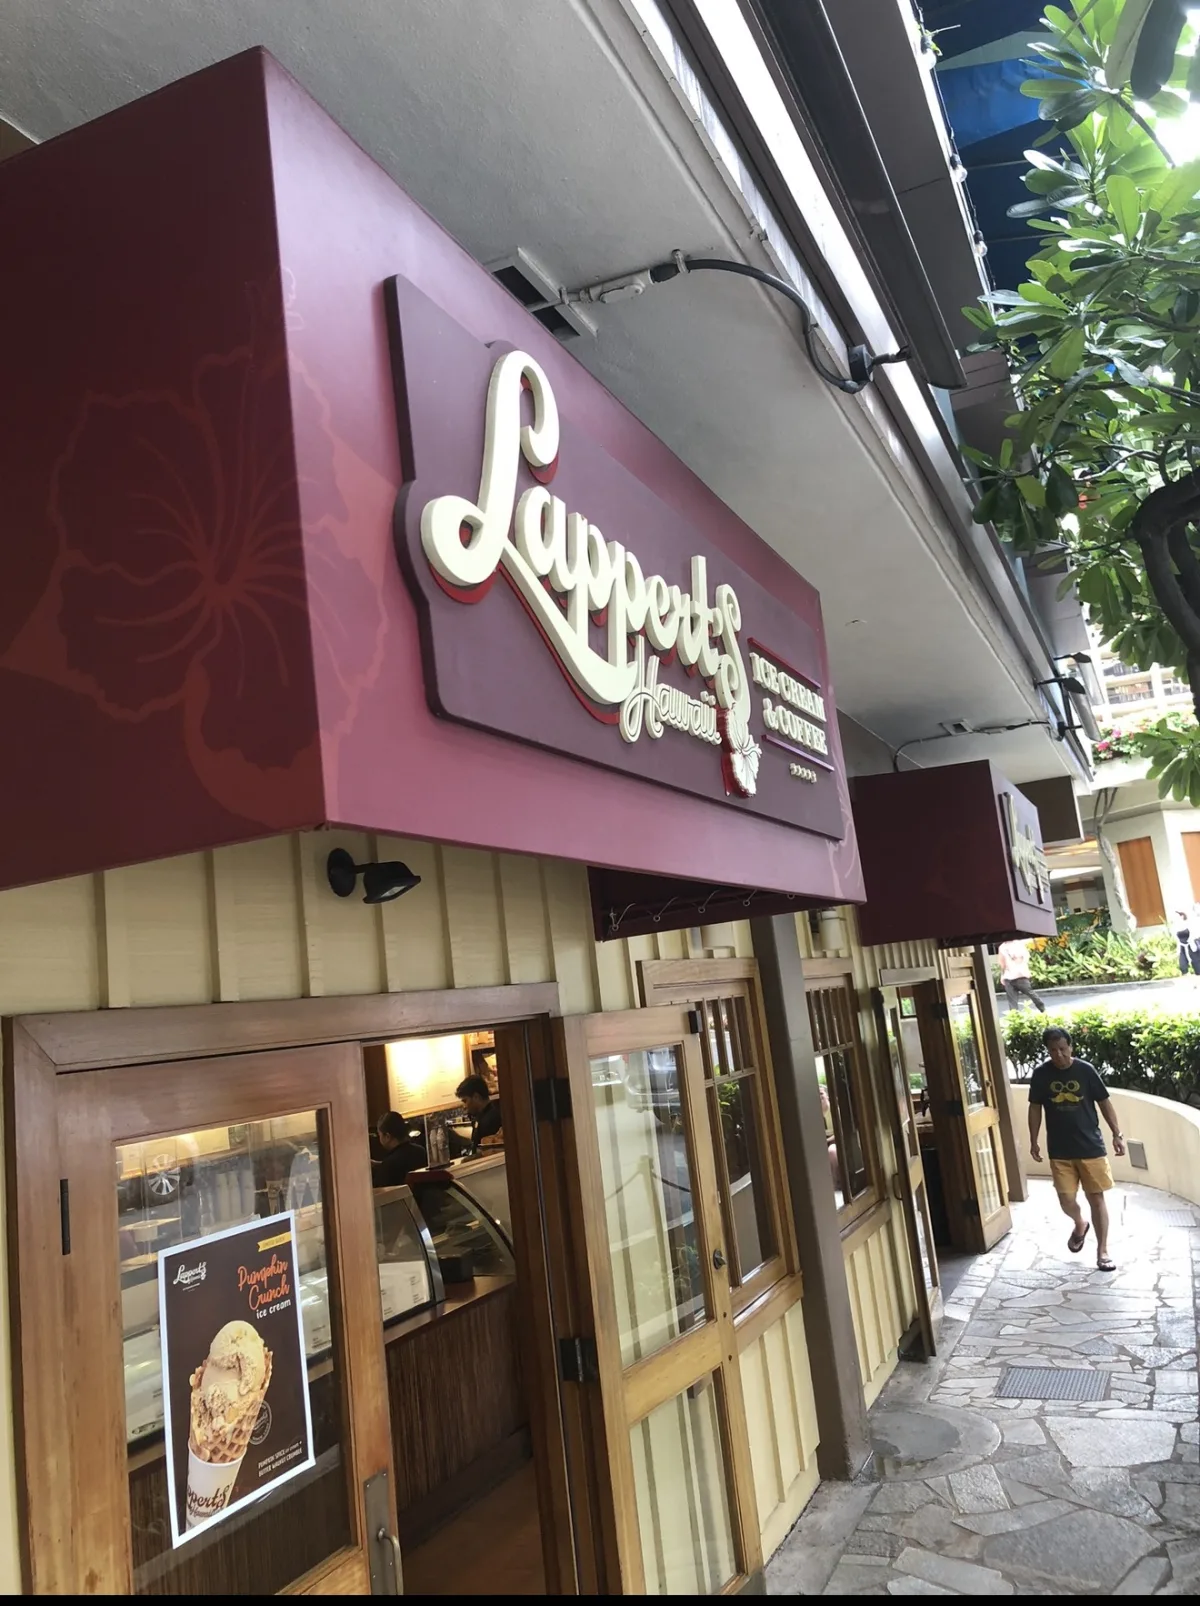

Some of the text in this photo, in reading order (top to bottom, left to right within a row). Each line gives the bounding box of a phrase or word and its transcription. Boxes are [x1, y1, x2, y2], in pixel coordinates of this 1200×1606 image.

[420, 350, 750, 722] Lappert's
[619, 634, 722, 746] Hawaii
[749, 652, 827, 722] ICE CREAM
[237, 1254, 289, 1291] Pumpkin
[249, 1274, 290, 1310] Crunch
[256, 1299, 291, 1319] ice cream
